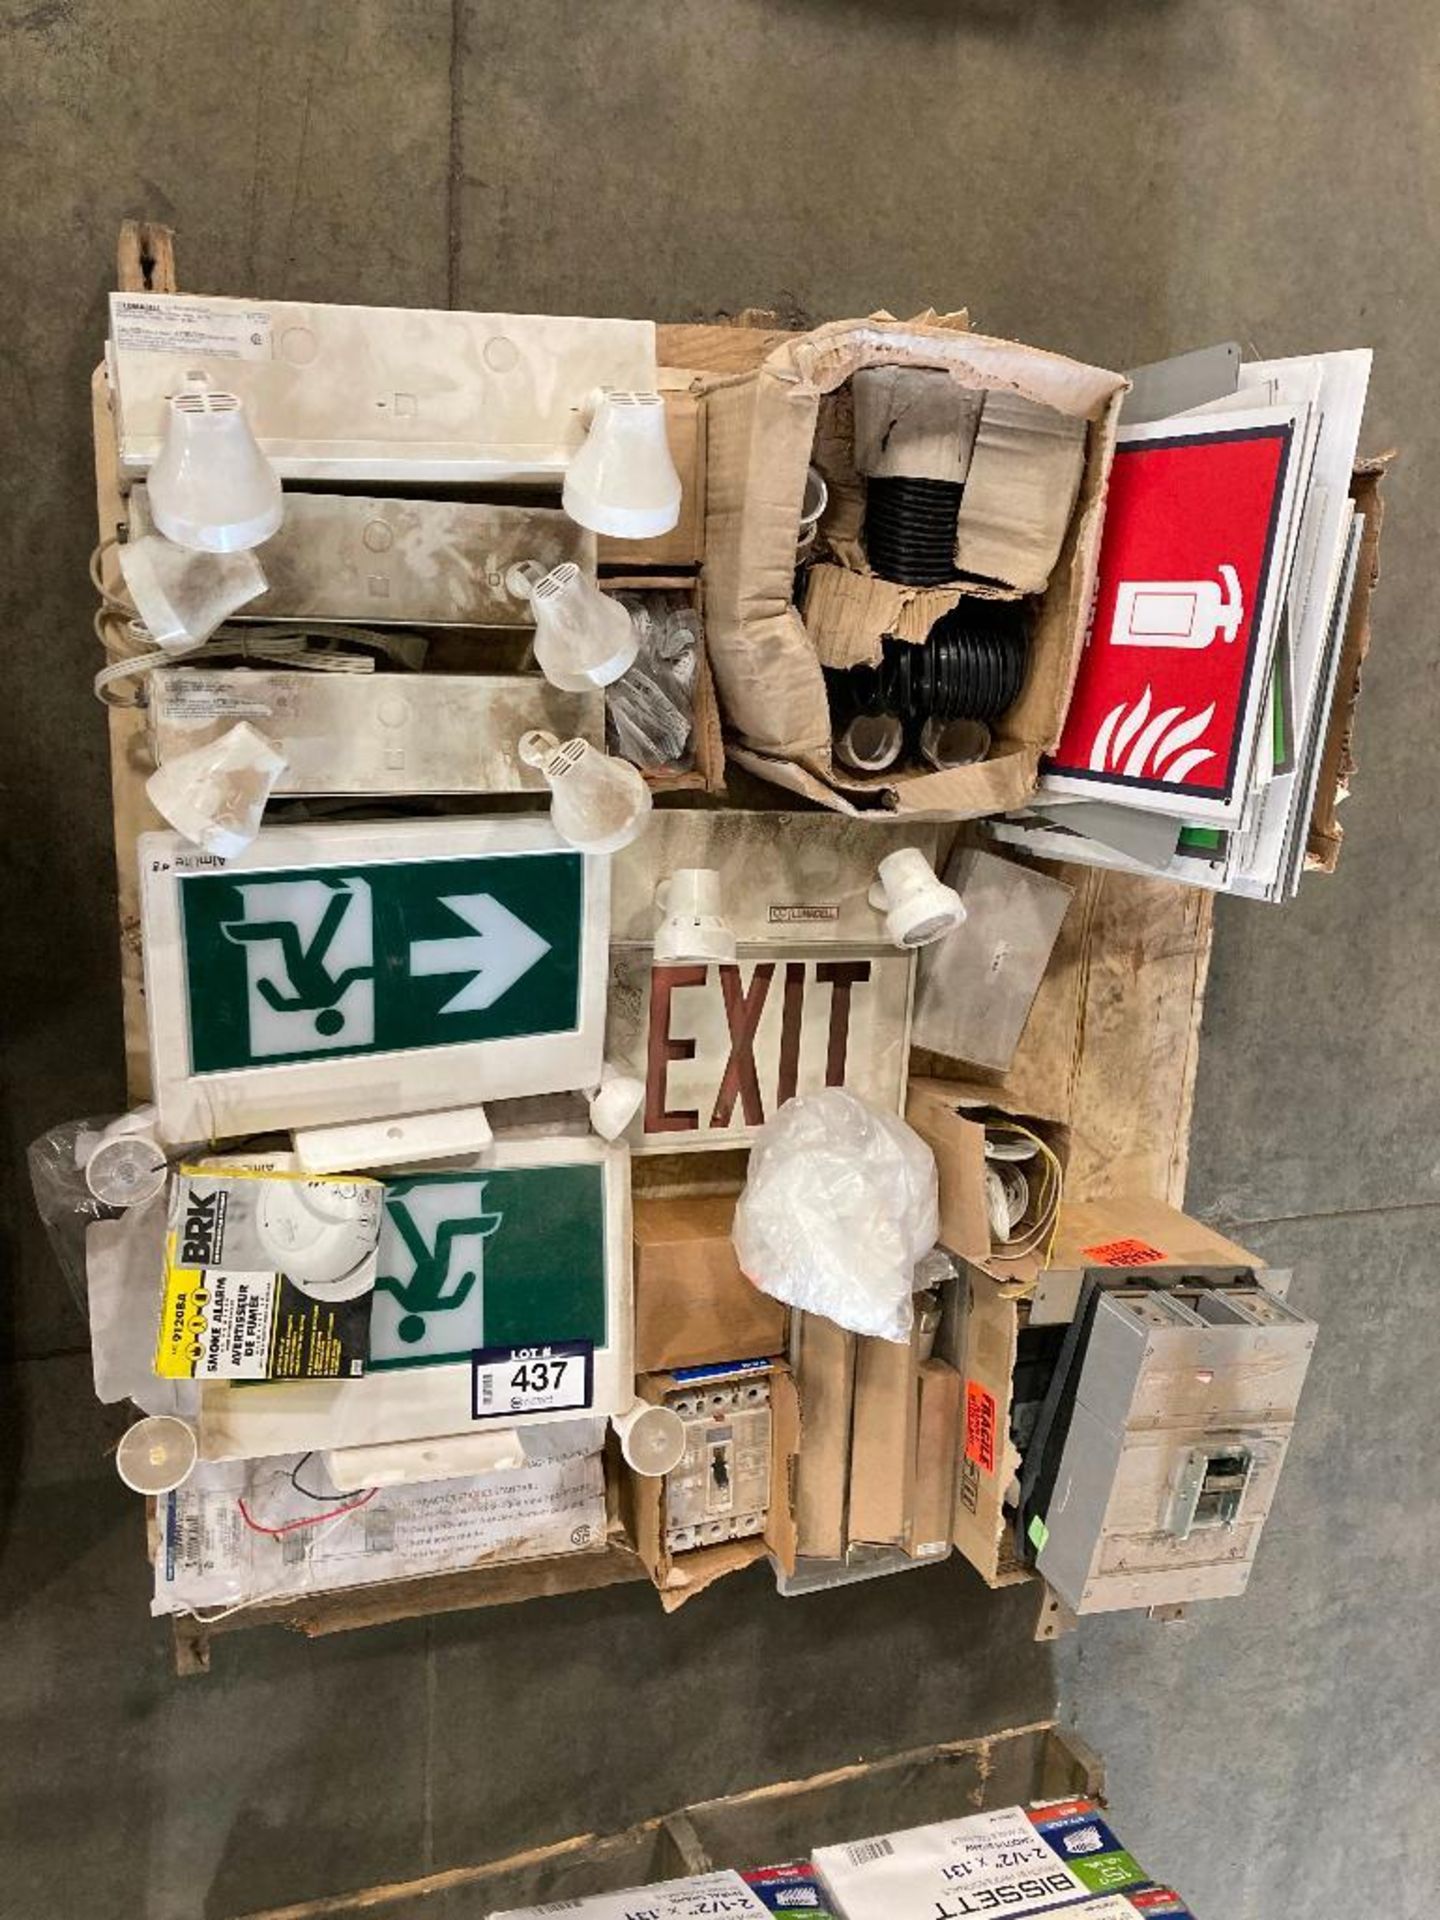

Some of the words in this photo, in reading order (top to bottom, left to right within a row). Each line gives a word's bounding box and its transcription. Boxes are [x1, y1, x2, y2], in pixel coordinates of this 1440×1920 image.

[644, 960, 871, 1133] EXIT
[181, 1190, 217, 1264] BRK
[212, 1277, 227, 1322] ALARM
[231, 1284, 249, 1366] AVERTISSEUR
[207, 1328, 221, 1372] SMOKE
[244, 1341, 255, 1357] DE
[510, 1348, 538, 1360] LOT
[510, 1361, 568, 1392] 437
[935, 1872, 1076, 1920] BISSETT
